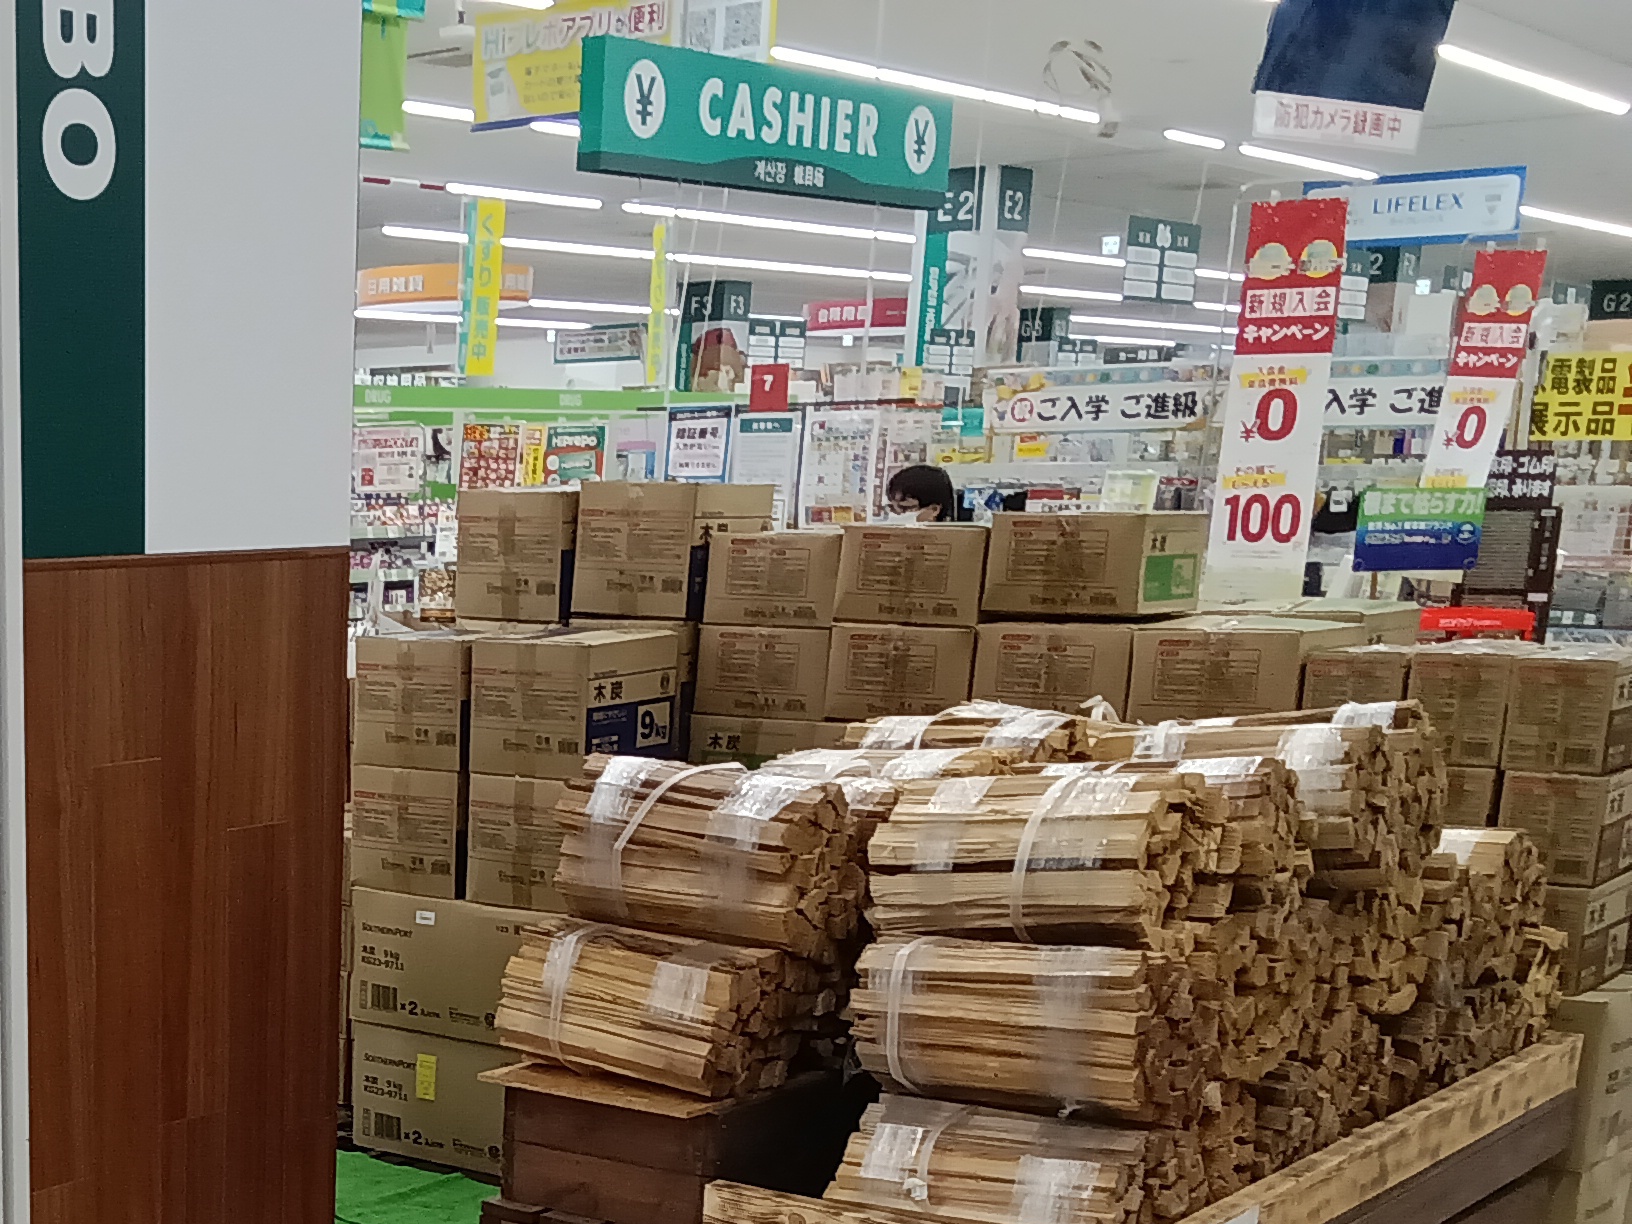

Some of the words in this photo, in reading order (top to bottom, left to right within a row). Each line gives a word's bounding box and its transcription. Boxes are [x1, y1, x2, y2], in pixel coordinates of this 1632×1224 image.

[698, 77, 879, 157] CASHIER
[1274, 100, 1402, 141] 防犯カメラ録画中
[1004, 189, 1024, 221] E2
[1372, 192, 1466, 216] LIFELEX
[730, 295, 745, 315] F3
[1248, 289, 1331, 316] 新規入会
[1243, 323, 1330, 344] キャンペーン
[1456, 350, 1519, 369] キャンペーン
[763, 374, 774, 393] 7
[1535, 357, 1618, 396] 電製品
[1037, 394, 1110, 422] ご入学
[1120, 390, 1198, 420] ご進級
[1529, 401, 1617, 436] 展示品
[1224, 493, 1301, 544] 100
[593, 680, 624, 704] 木炭
[709, 732, 741, 752] 木炭
